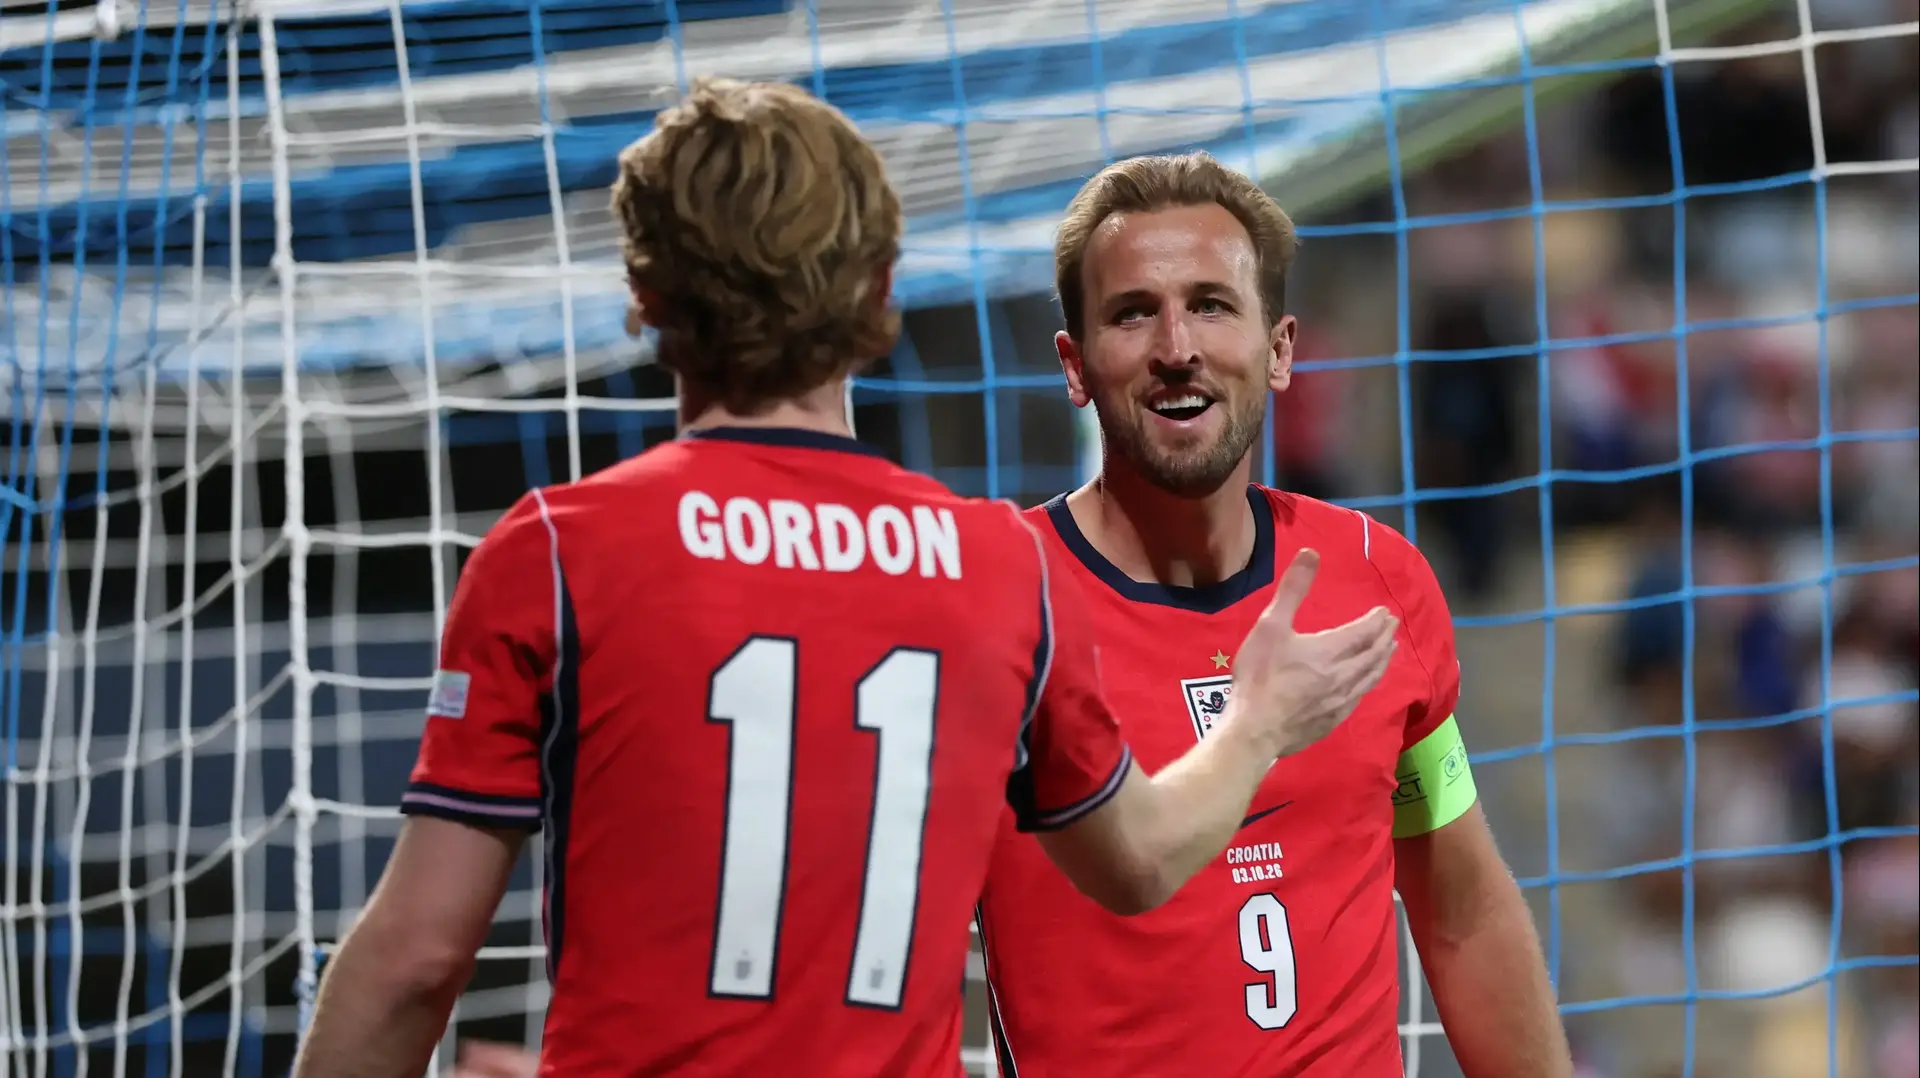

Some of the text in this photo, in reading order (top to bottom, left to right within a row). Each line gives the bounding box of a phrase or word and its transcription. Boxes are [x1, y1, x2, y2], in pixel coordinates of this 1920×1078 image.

[677, 489, 962, 580] GORDON
[706, 633, 942, 1011] 11
[1226, 842, 1283, 865] CROATIA
[1231, 863, 1283, 884] 03.10.26
[1237, 892, 1298, 1031] 9
